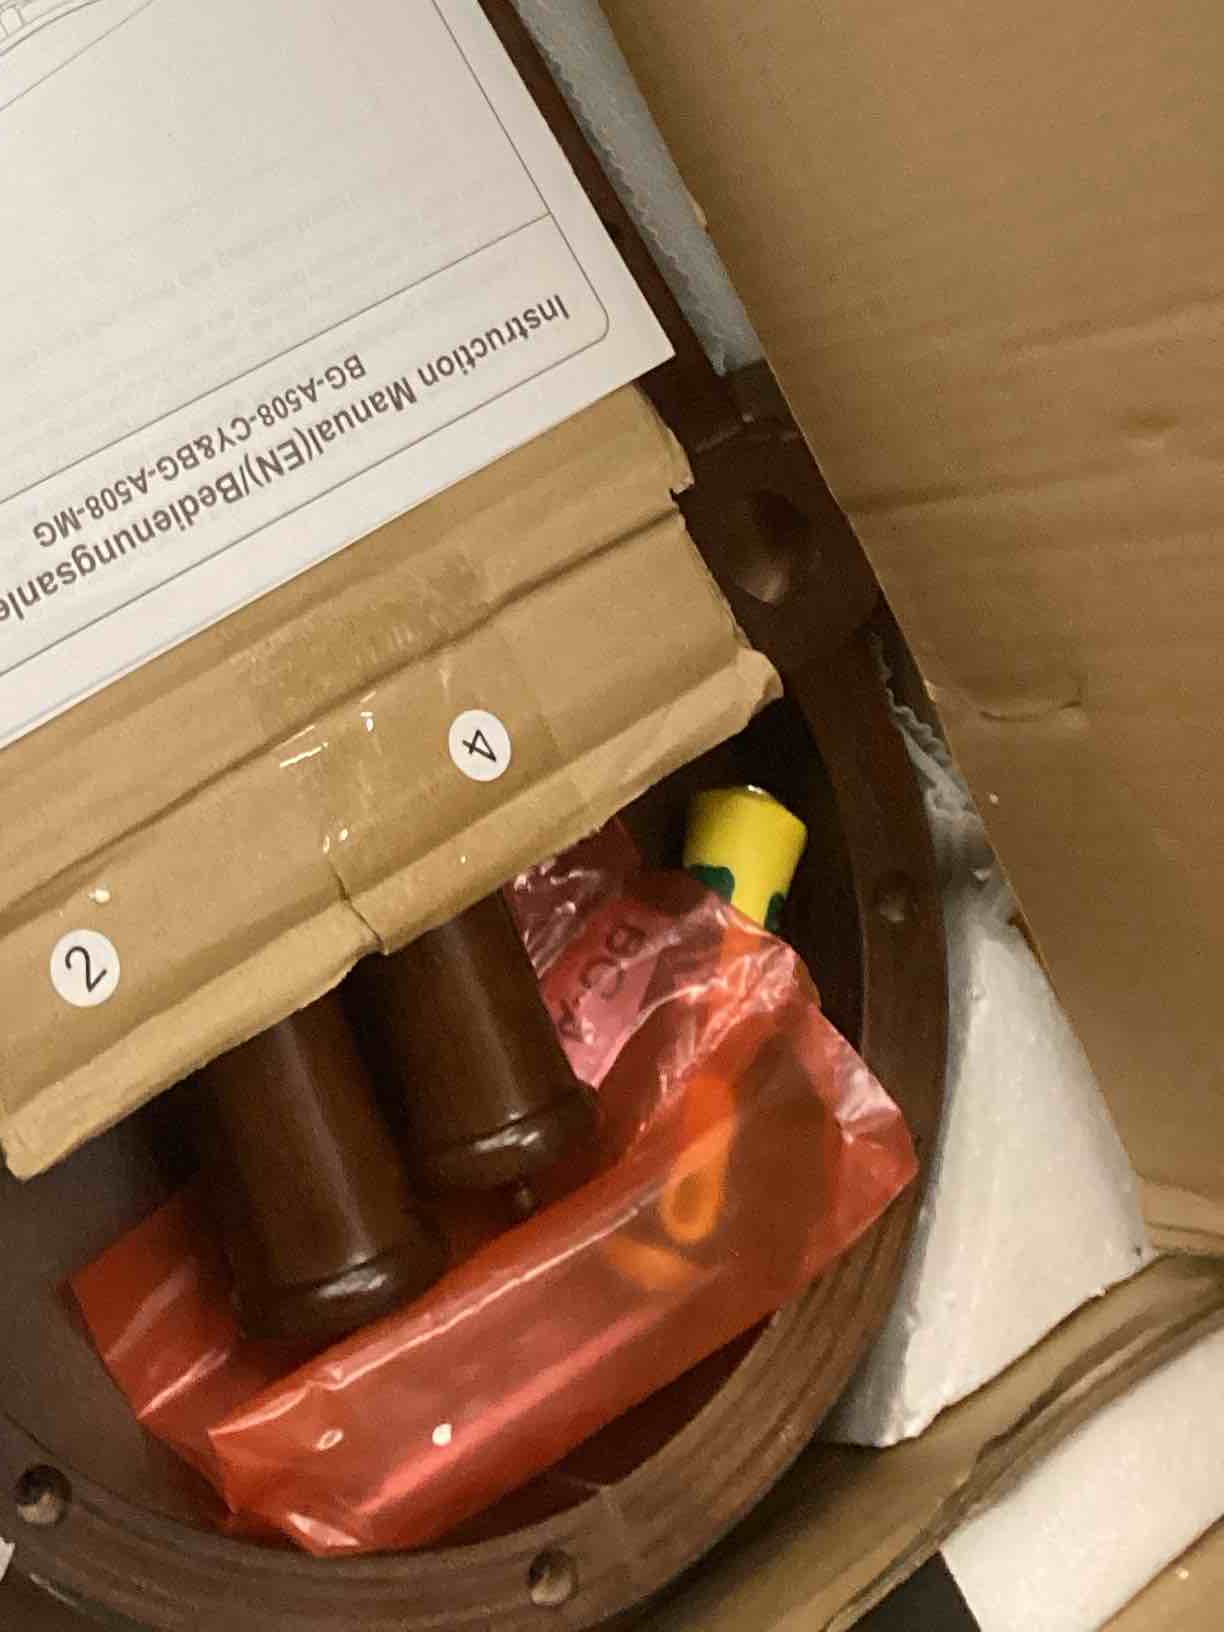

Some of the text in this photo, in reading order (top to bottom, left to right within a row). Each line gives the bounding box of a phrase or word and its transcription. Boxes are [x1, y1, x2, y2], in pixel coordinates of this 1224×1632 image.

[416, 294, 571, 387] Instruction
[32, 354, 367, 548] BG-A508-CY&BG-A508-MG
[461, 728, 497, 763] 4
[64, 945, 107, 993] 2
